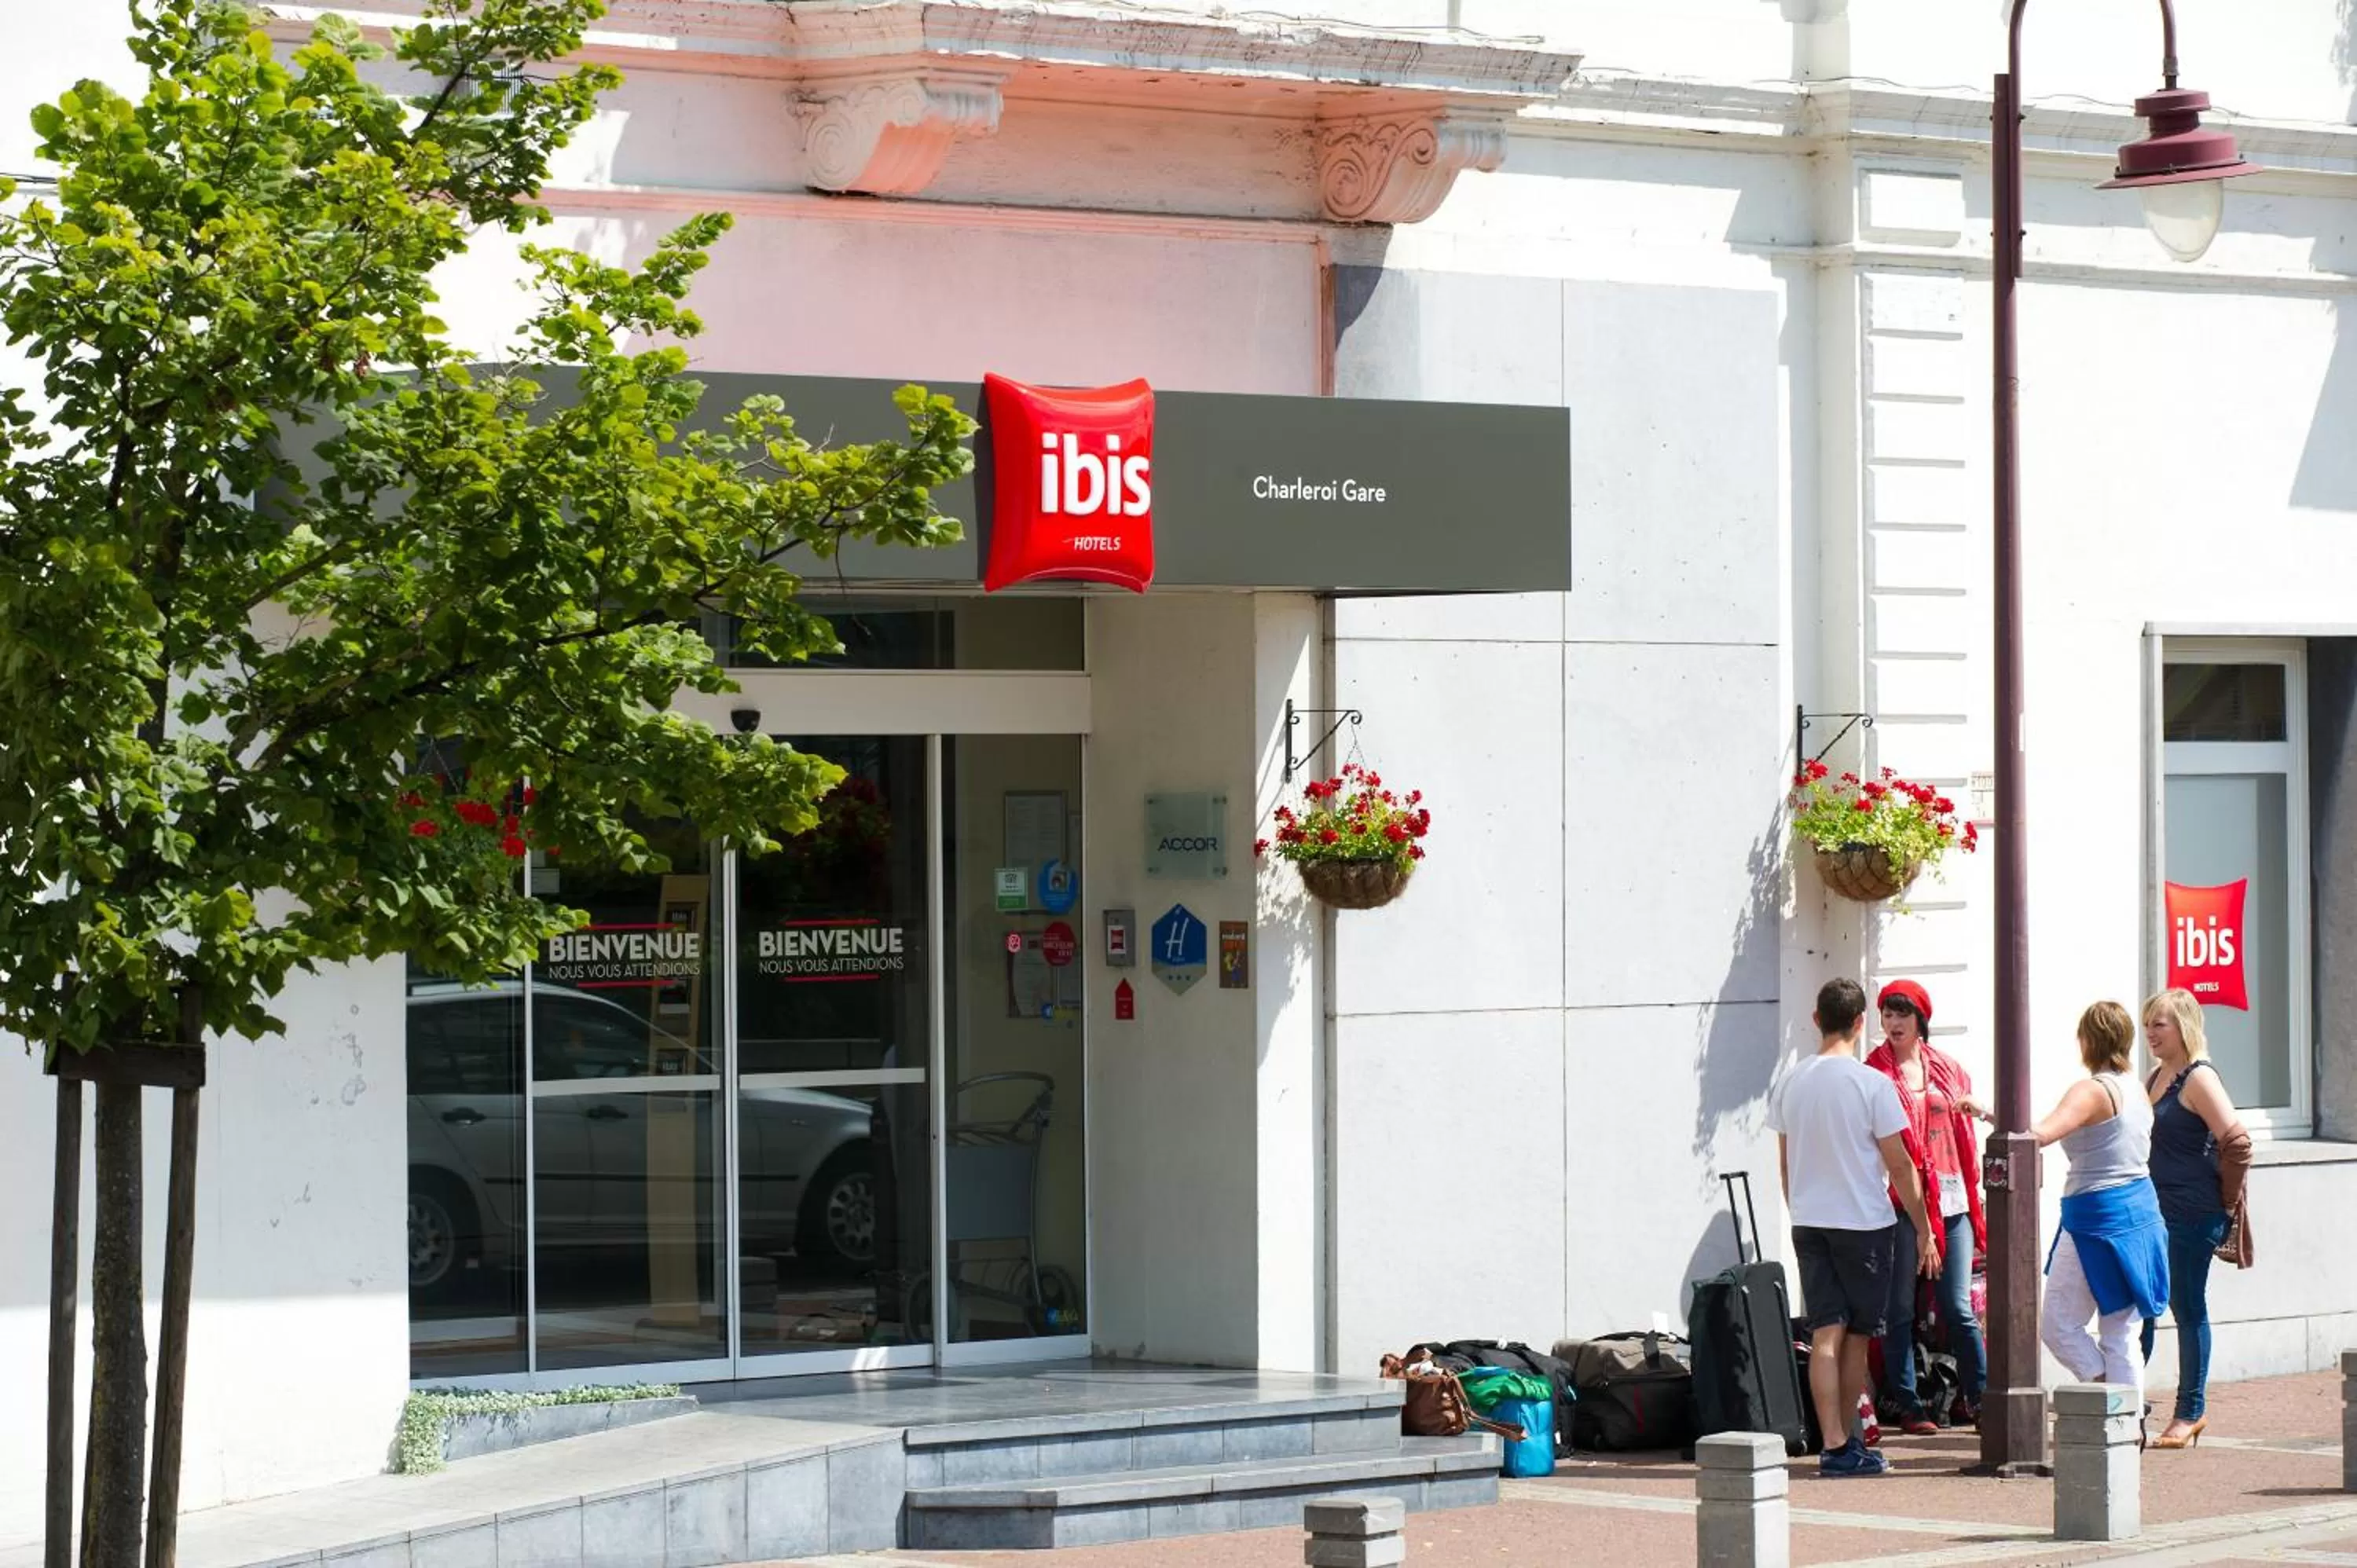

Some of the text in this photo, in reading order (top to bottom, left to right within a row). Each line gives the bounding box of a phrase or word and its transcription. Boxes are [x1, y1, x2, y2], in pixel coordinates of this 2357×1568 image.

[1041, 432, 1151, 516] ibis
[1253, 475, 1387, 502] Charleroi Gare
[1074, 536, 1121, 551] HOTELS
[1157, 837, 1217, 852] ACCOR
[549, 932, 700, 962] BIENVENUE
[759, 928, 904, 957] BIENVENUE
[2177, 915, 2235, 967] ibis
[550, 962, 700, 980] NOUS VOUS ATTENDIONS
[760, 956, 904, 973] NOUS VOUS ATTENDIONS
